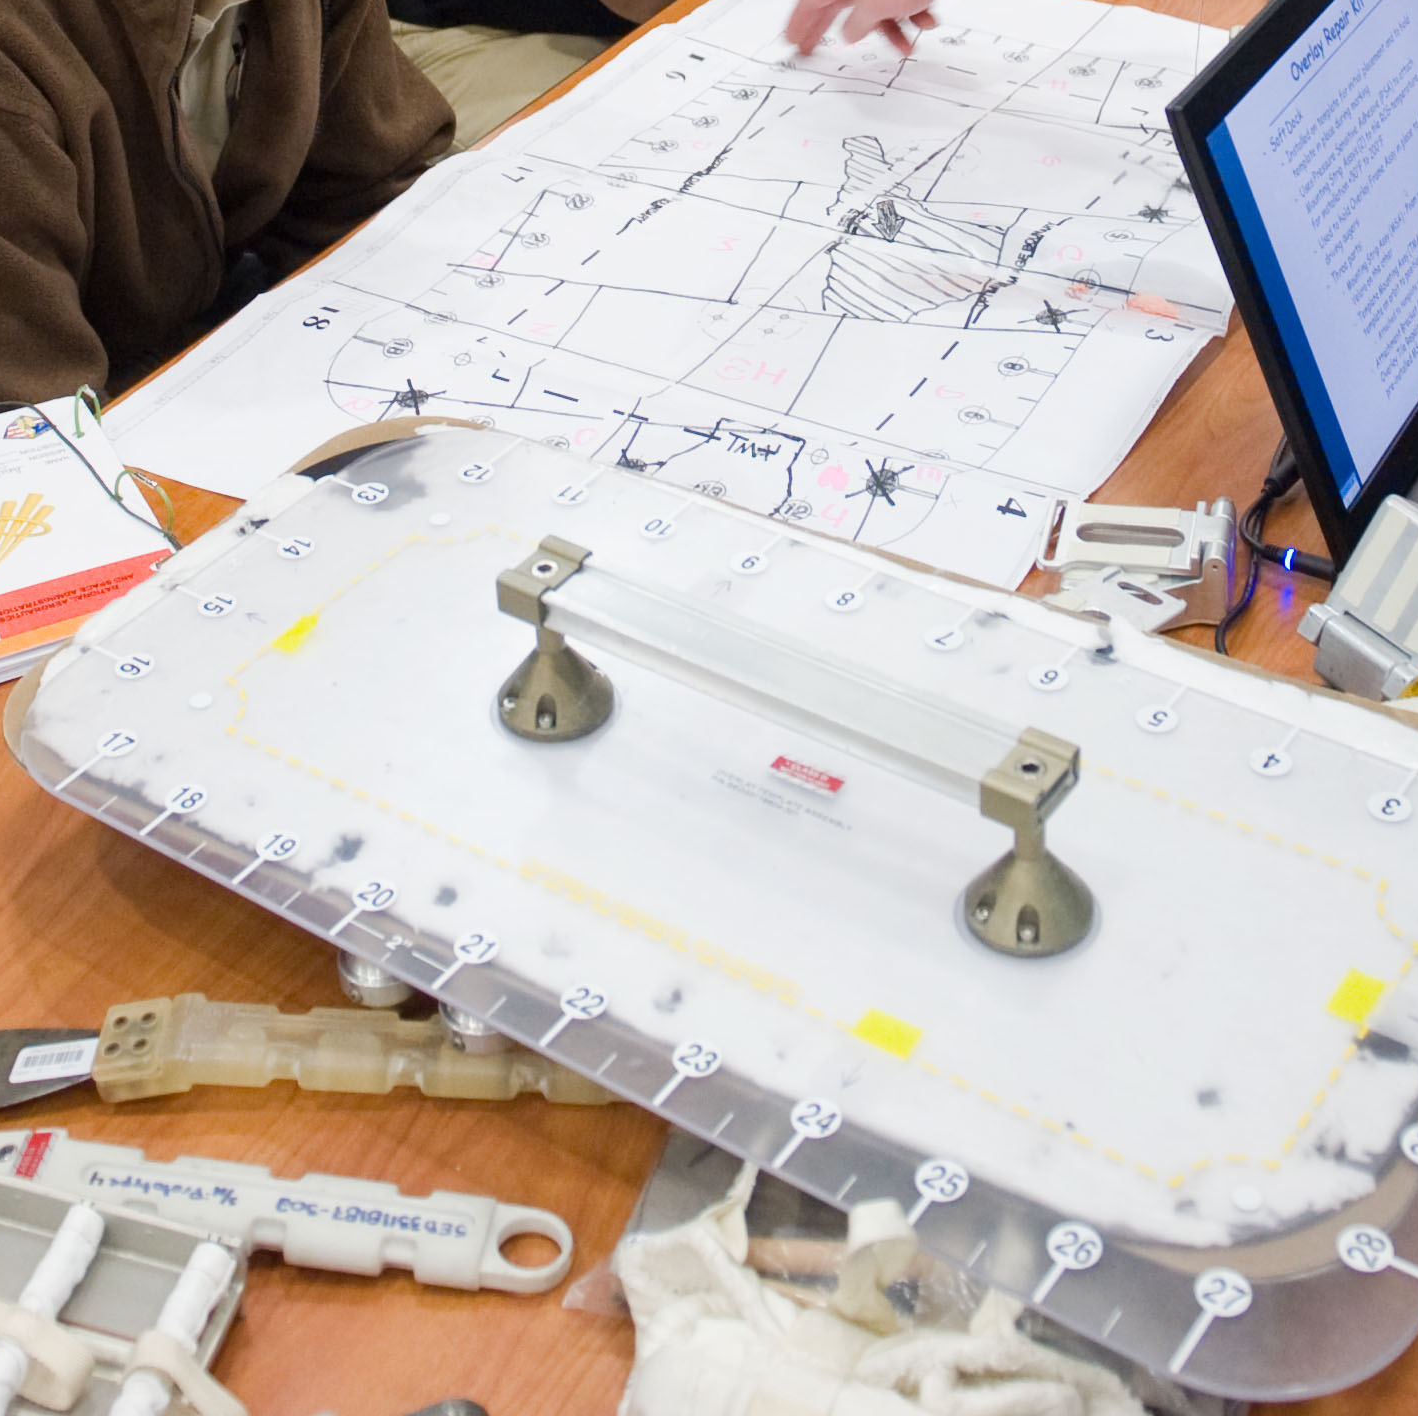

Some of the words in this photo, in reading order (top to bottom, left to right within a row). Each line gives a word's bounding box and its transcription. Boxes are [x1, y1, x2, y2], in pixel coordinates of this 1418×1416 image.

[1290, 41, 1324, 80] Overlay
[1322, 10, 1349, 43] Repair
[1285, 128, 1310, 162] Installed
[1310, 123, 1317, 135] on
[1316, 98, 1339, 125] template
[1338, 87, 1347, 101] for
[1347, 69, 1361, 91] initial
[1361, 43, 1384, 77] placement
[1385, 33, 1394, 48] and
[1392, 27, 1400, 37] to
[1398, 15, 1410, 30] hold
[1269, 127, 1285, 152] Soft
[1284, 108, 1303, 134] Dock
[1292, 148, 1315, 176] template
[1316, 142, 1321, 152] in
[1320, 126, 1335, 148] place
[1334, 107, 1351, 128] during
[1350, 85, 1370, 109] marking
[1299, 179, 1313, 197] Uses
[1311, 152, 1335, 179] Pressure
[1335, 126, 1357, 155] Sensitive
[1358, 100, 1379, 127] Adhesive
[1378, 80, 1393, 104] (PSA)
[1392, 76, 1399, 85] to
[1398, 58, 1413, 79] attach
[463, 463, 491, 479] 12
[356, 484, 385, 502] 13
[556, 486, 583, 502] 11
[644, 520, 673, 534] 10
[285, 539, 313, 557] 14
[741, 556, 759, 570] 9
[80, 578, 112, 592] SPACE
[113, 573, 134, 584] AND
[71, 584, 119, 602] NATIONAL
[836, 591, 855, 606] 8
[0, 599, 68, 623] AERONAUTICS
[205, 596, 232, 614] 15
[935, 631, 954, 645] 7
[121, 658, 149, 675] 16
[1039, 669, 1060, 684] 6
[1148, 711, 1169, 726] 5
[103, 733, 134, 751] 17
[1258, 752, 1281, 767] 4
[171, 786, 204, 811] 18
[1380, 798, 1402, 816] 3
[265, 832, 297, 859] 19
[360, 882, 394, 910] 20
[461, 933, 495, 960] 21
[567, 987, 606, 1016] 22
[678, 1044, 717, 1072] 23
[797, 1103, 837, 1134] 24
[109, 1176, 204, 1201] Prototype
[920, 1167, 962, 1197] 25
[1055, 1229, 1096, 1264] 26
[1346, 1234, 1386, 1267] 28
[1203, 1279, 1245, 1310] 27
